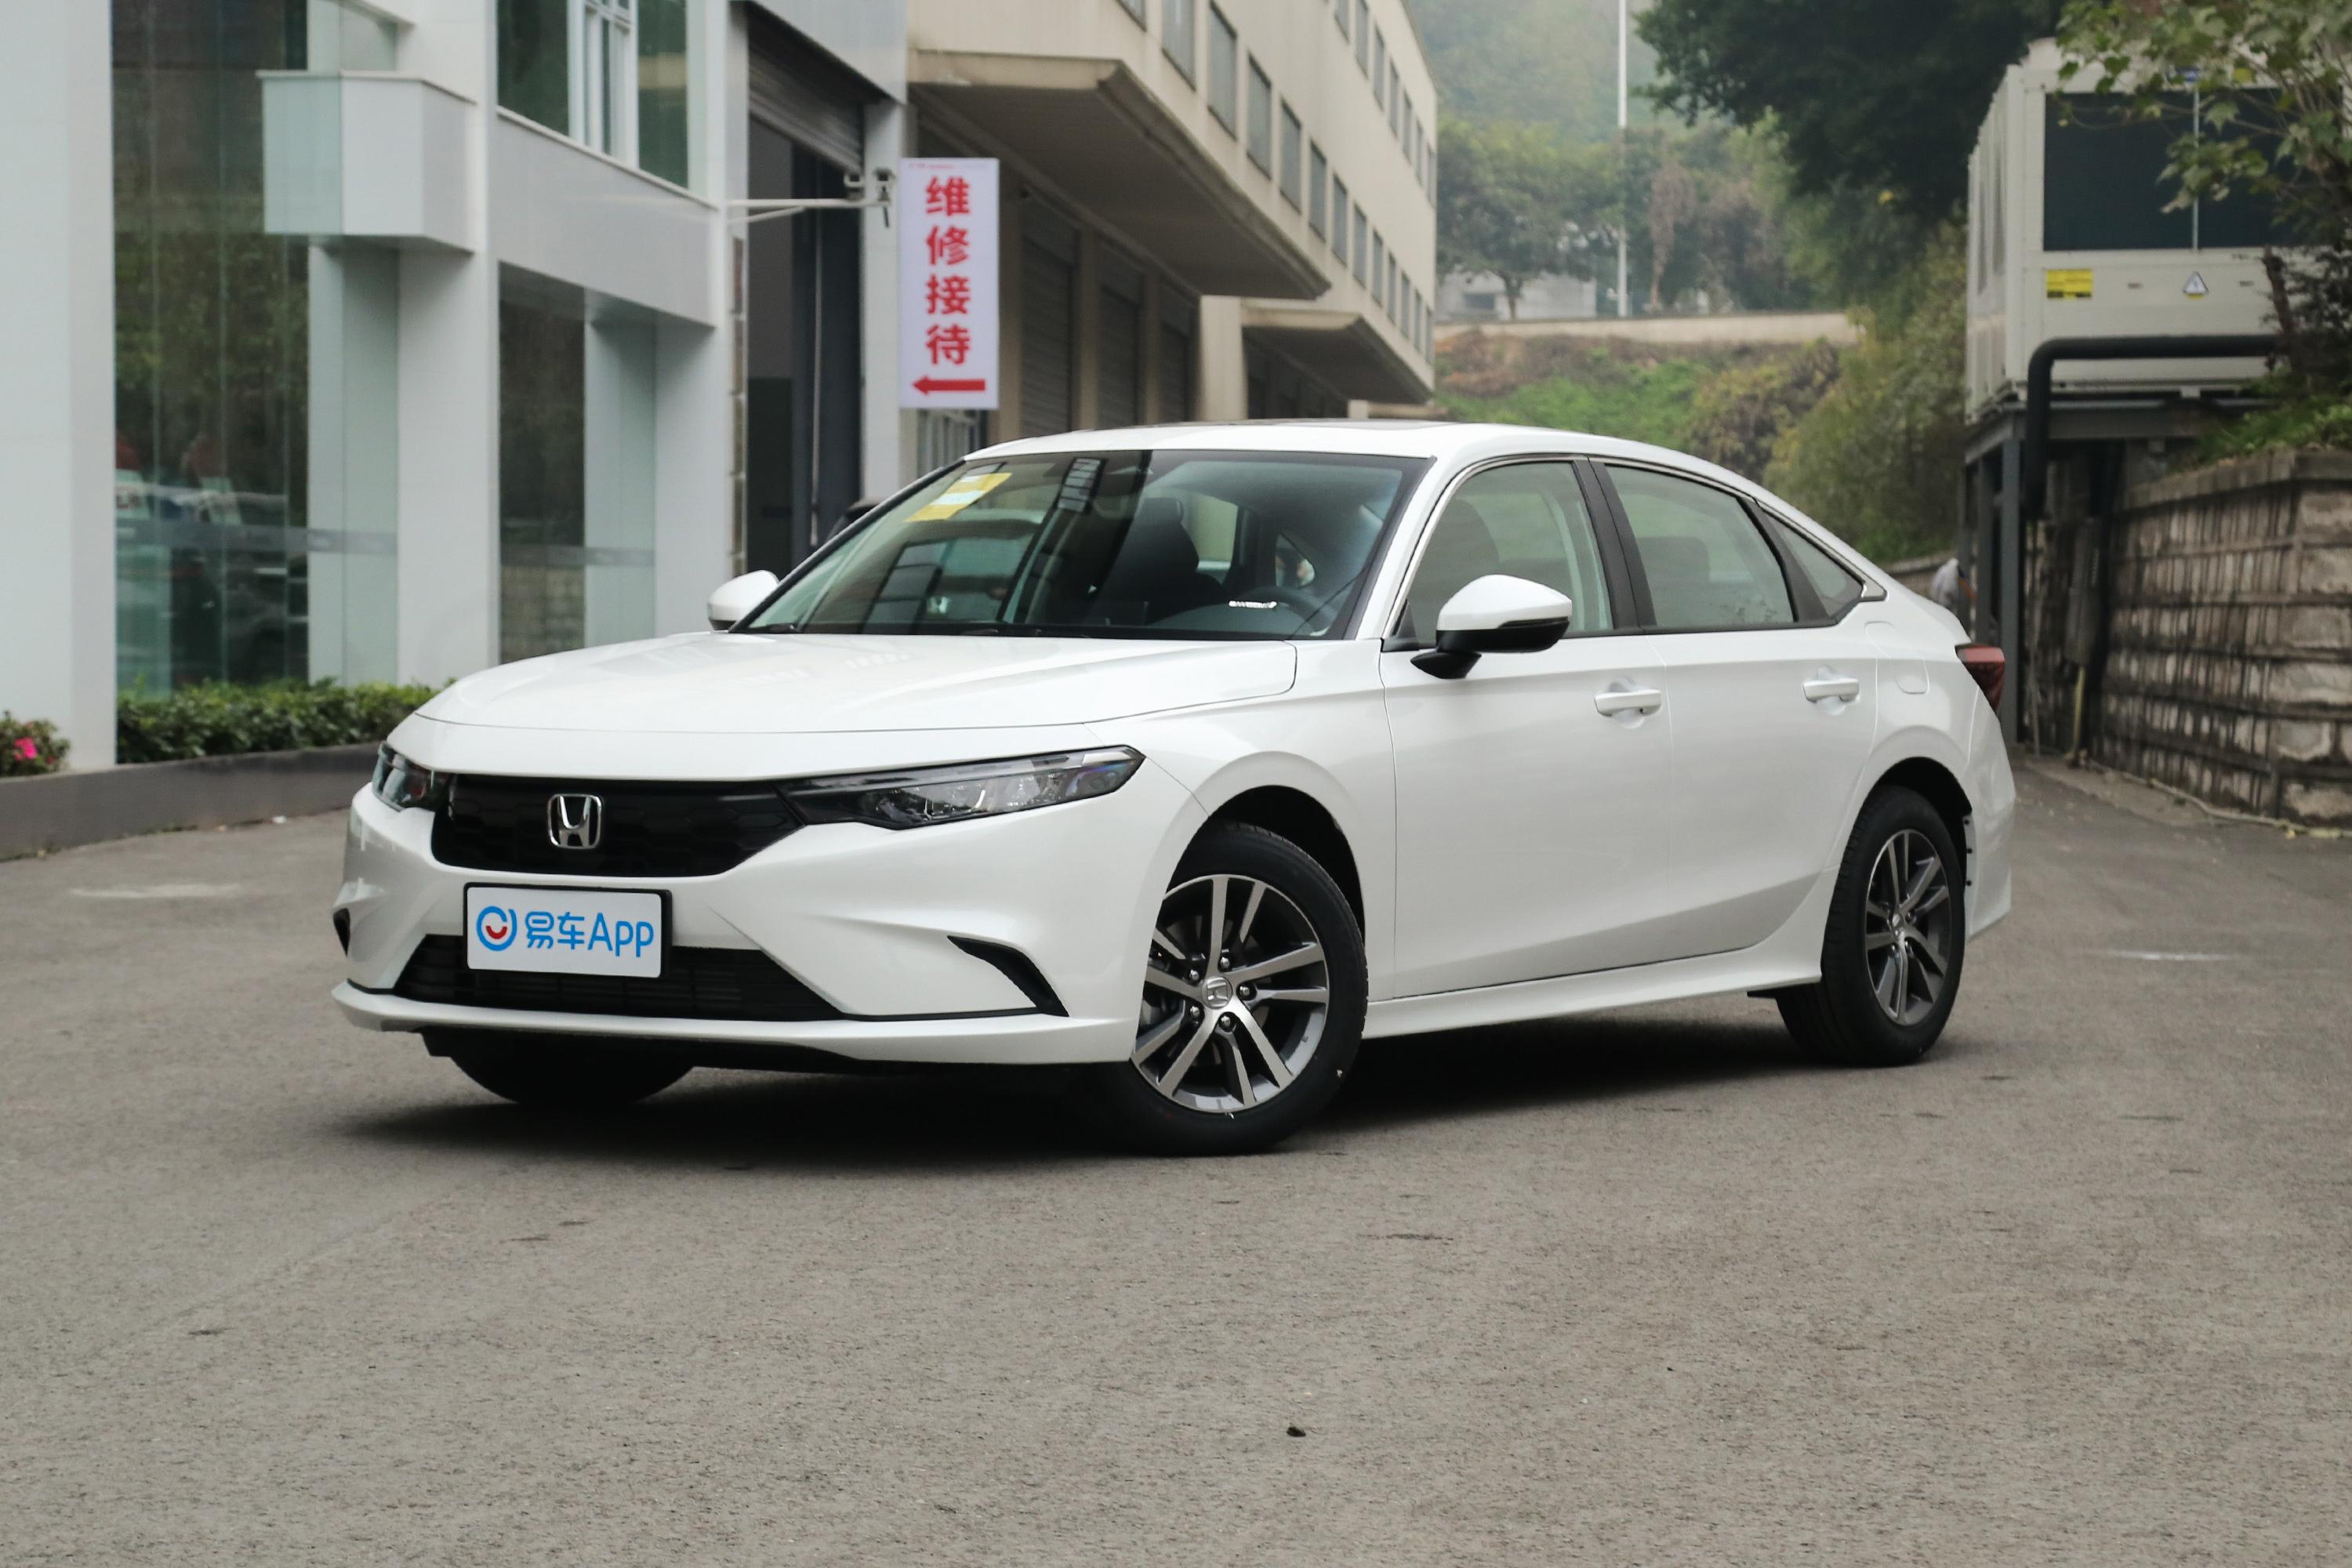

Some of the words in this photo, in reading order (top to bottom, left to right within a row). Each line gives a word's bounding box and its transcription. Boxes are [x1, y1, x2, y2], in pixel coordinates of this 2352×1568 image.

[925, 176, 971, 365] 维修接待
[524, 910, 655, 958] 易车App
